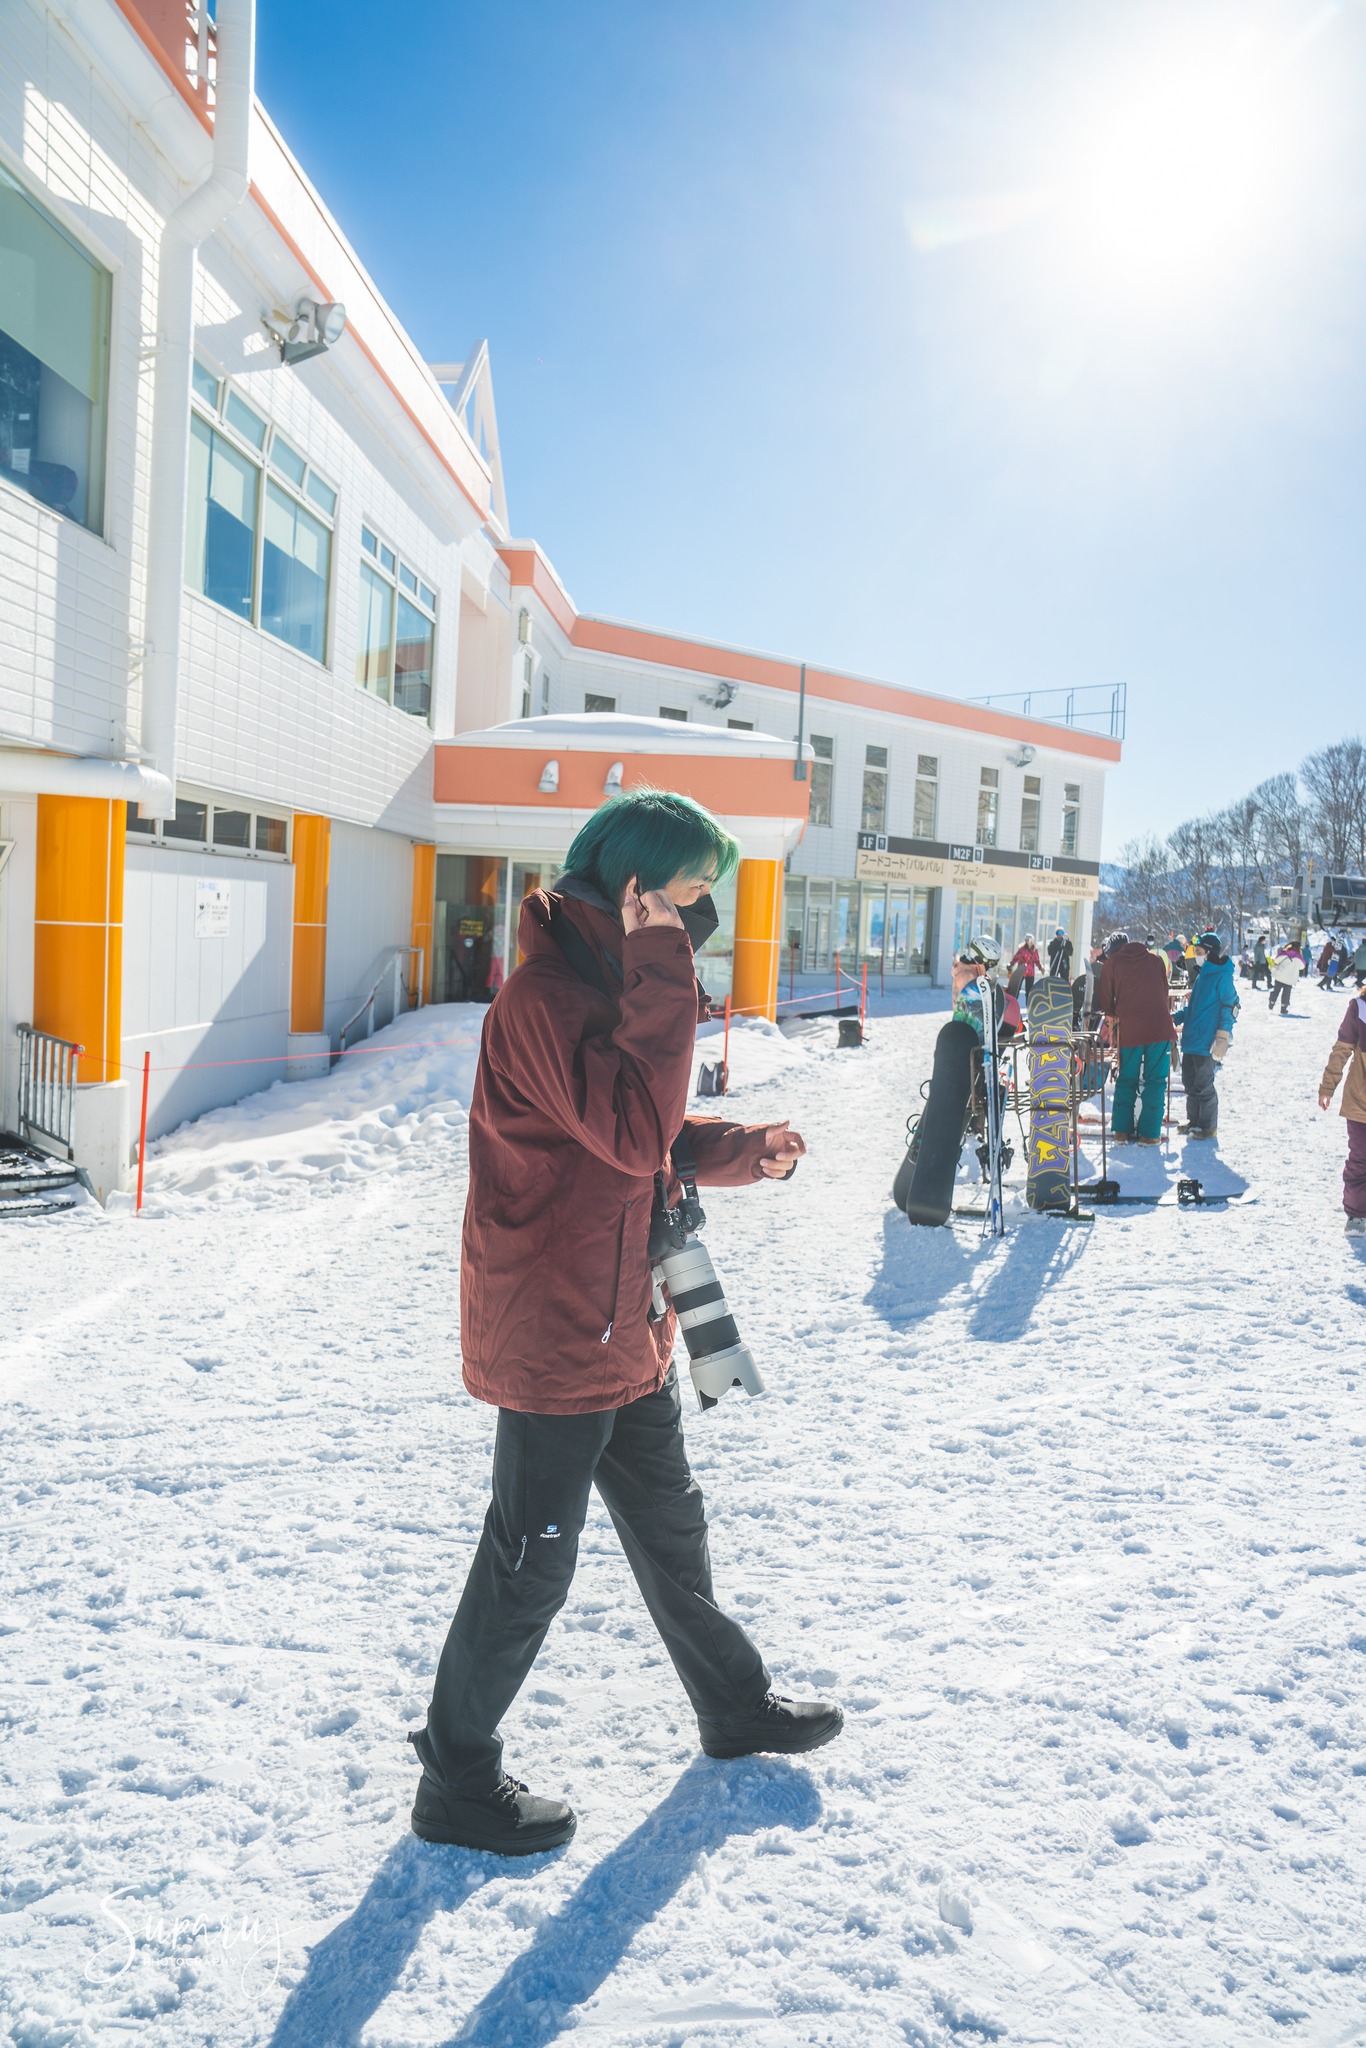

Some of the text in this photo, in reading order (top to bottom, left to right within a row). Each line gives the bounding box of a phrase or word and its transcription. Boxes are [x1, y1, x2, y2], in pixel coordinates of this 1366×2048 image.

[862, 836, 874, 849] 1F
[953, 847, 971, 860] M2F
[1032, 857, 1042, 868] 2F
[887, 871, 907, 880] PALPAL
[953, 864, 996, 878] ブルーシール
[966, 879, 977, 887] SEAL
